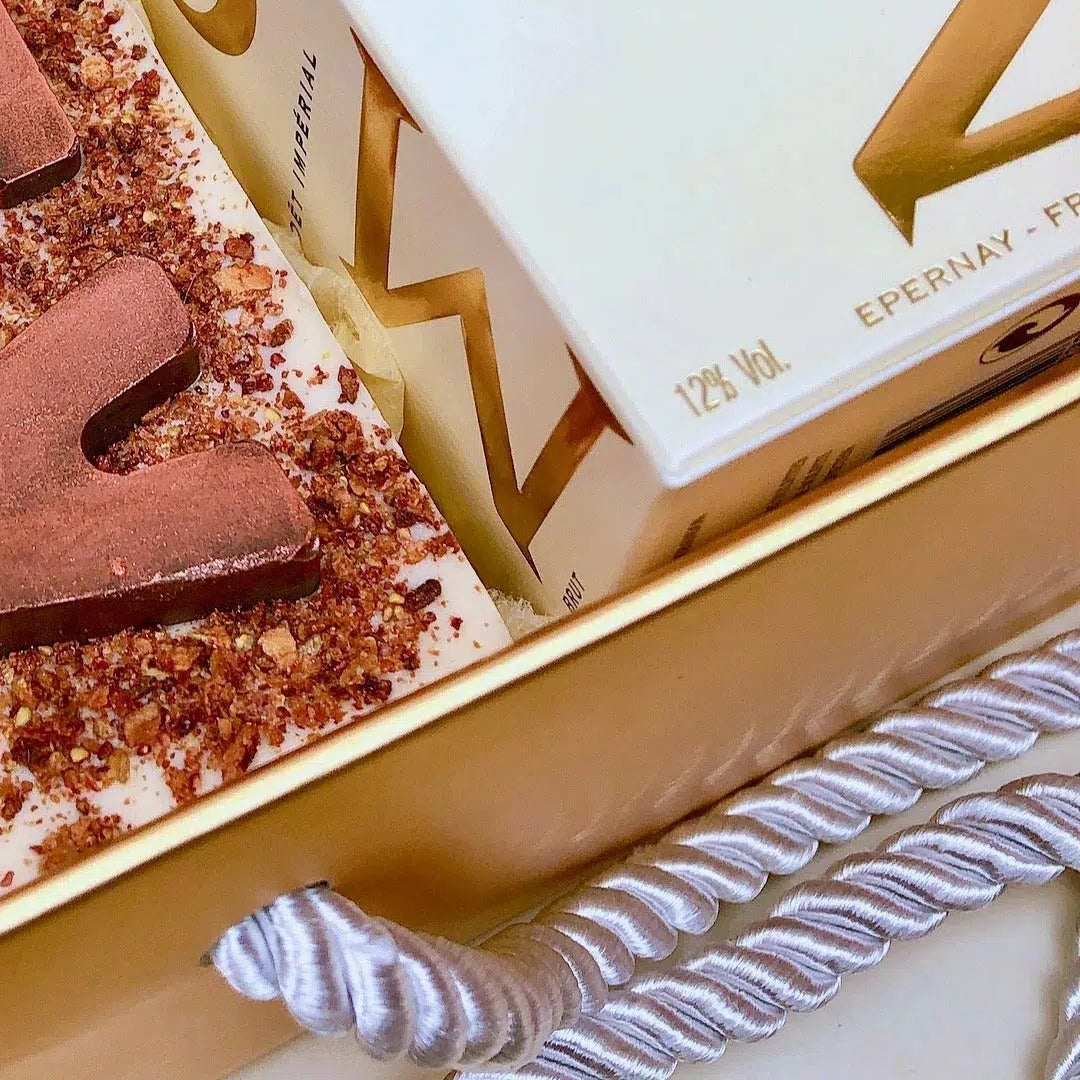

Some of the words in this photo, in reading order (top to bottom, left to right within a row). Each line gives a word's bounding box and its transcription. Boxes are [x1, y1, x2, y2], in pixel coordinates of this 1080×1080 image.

[292, 48, 317, 189] IMPÉRIAL
[854, 228, 1014, 329] EPERNAY
[672, 362, 739, 418] 12%
[727, 337, 793, 387] Vol.
[562, 570, 586, 613] BRUT
